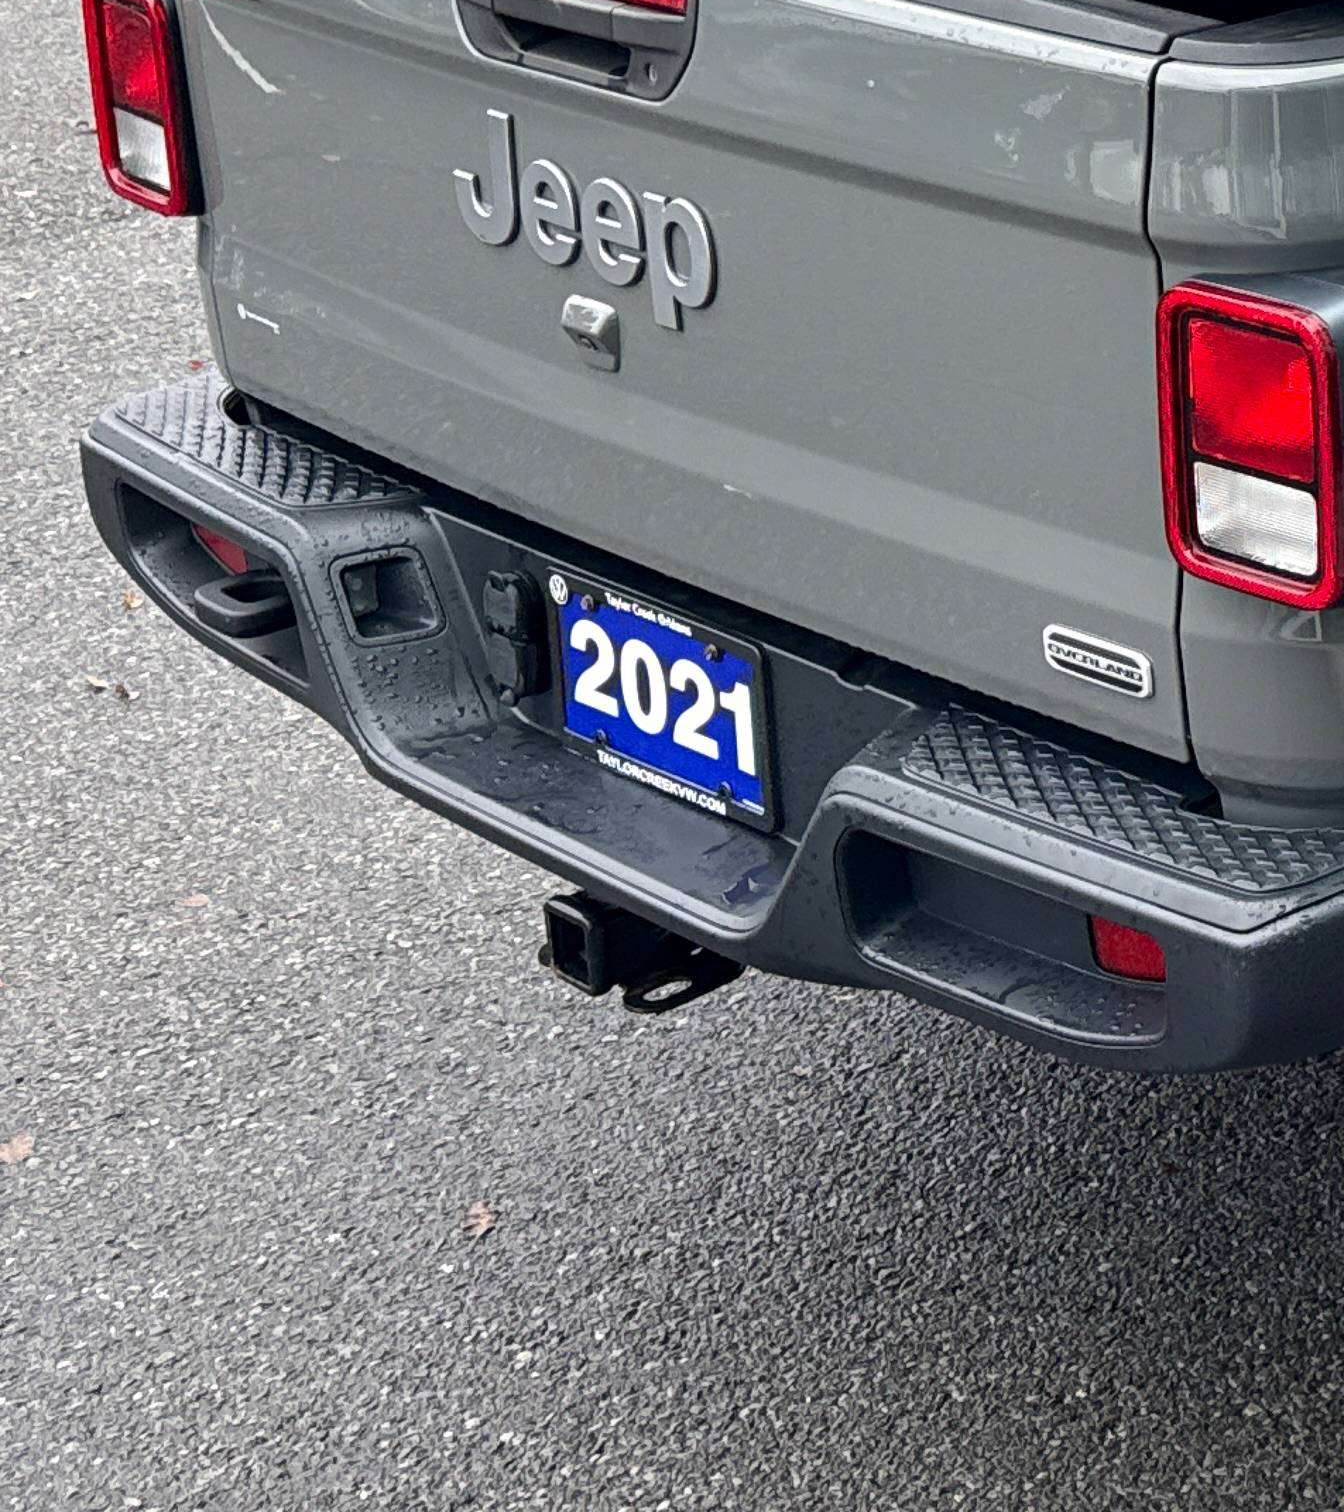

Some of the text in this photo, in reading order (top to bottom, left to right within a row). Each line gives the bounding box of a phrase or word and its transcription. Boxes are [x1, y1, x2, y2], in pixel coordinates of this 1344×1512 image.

[452, 108, 717, 332] Jeep
[569, 619, 757, 776] 2021
[1048, 642, 1144, 683] OVERLAND
